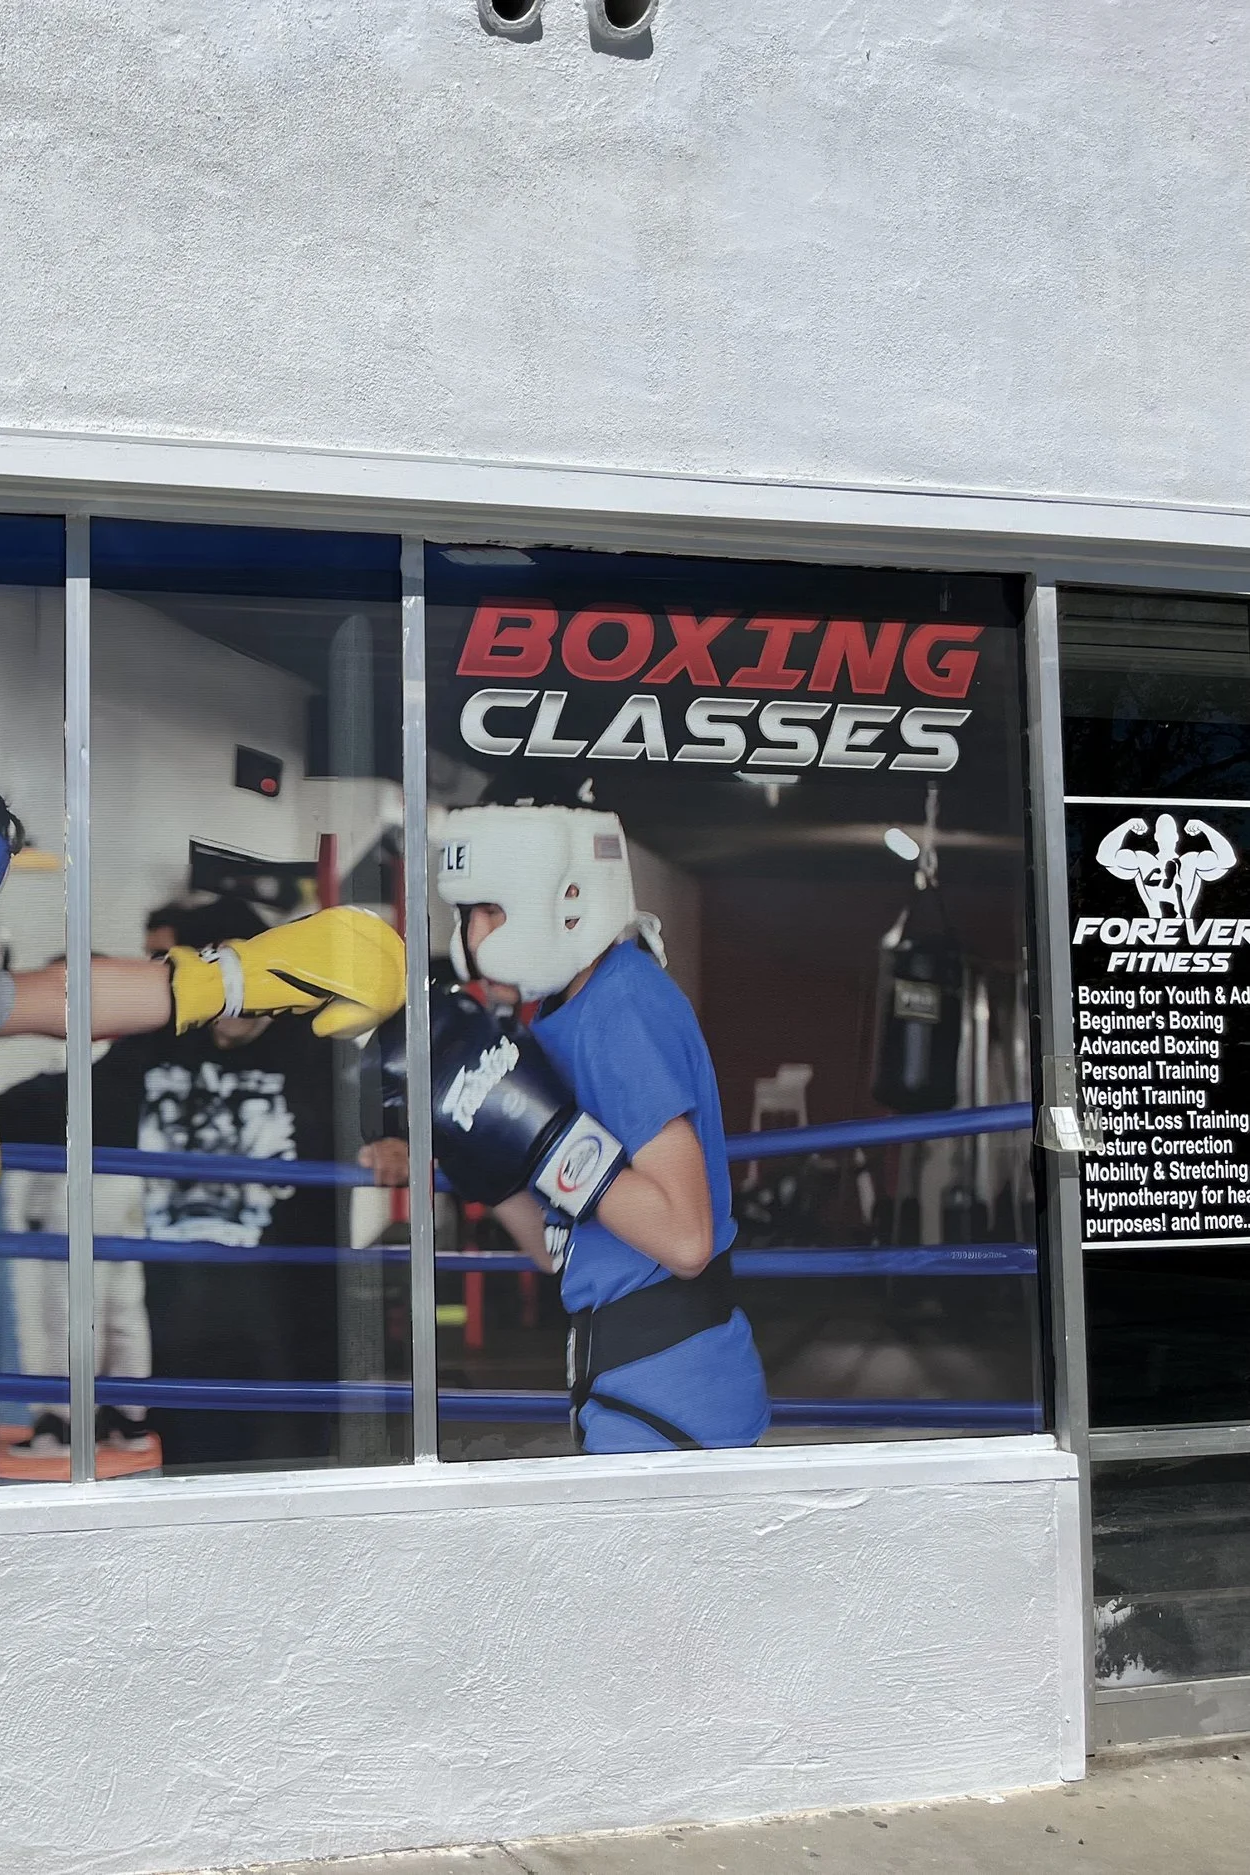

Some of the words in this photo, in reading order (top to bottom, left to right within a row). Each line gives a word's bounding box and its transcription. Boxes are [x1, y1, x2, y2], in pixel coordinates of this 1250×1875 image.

[456, 597, 988, 699] BOXING
[459, 688, 973, 773] CLASSES
[1072, 917, 1250, 946] FOREVER
[1107, 952, 1231, 972] FITNESS
[1079, 986, 1135, 1009] Boxing
[1139, 986, 1162, 1004] for
[1165, 986, 1210, 1004] Youth
[1215, 986, 1226, 1004] &
[1080, 1011, 1165, 1034] Beginner's
[1170, 1011, 1223, 1033] Boxing
[1080, 1036, 1159, 1056] Advanced
[1164, 1036, 1219, 1058] Boxing
[1082, 1061, 1151, 1080] Personal
[1156, 1061, 1219, 1083] Training
[1081, 1086, 1138, 1110] Weight
[1142, 1086, 1205, 1108] Training
[1083, 1111, 1182, 1135] Weight-Loss
[1187, 1110, 1249, 1132] Training
[1084, 1137, 1147, 1156] Posture
[1152, 1135, 1232, 1155] Correction
[1086, 1162, 1148, 1185] Mobility
[1153, 1162, 1165, 1180] &
[1170, 1160, 1248, 1182] Stretching
[1087, 1187, 1197, 1211] Hypnotherapy
[1202, 1186, 1223, 1204] for
[1087, 1213, 1166, 1237] purposes!
[1171, 1212, 1200, 1230] and
